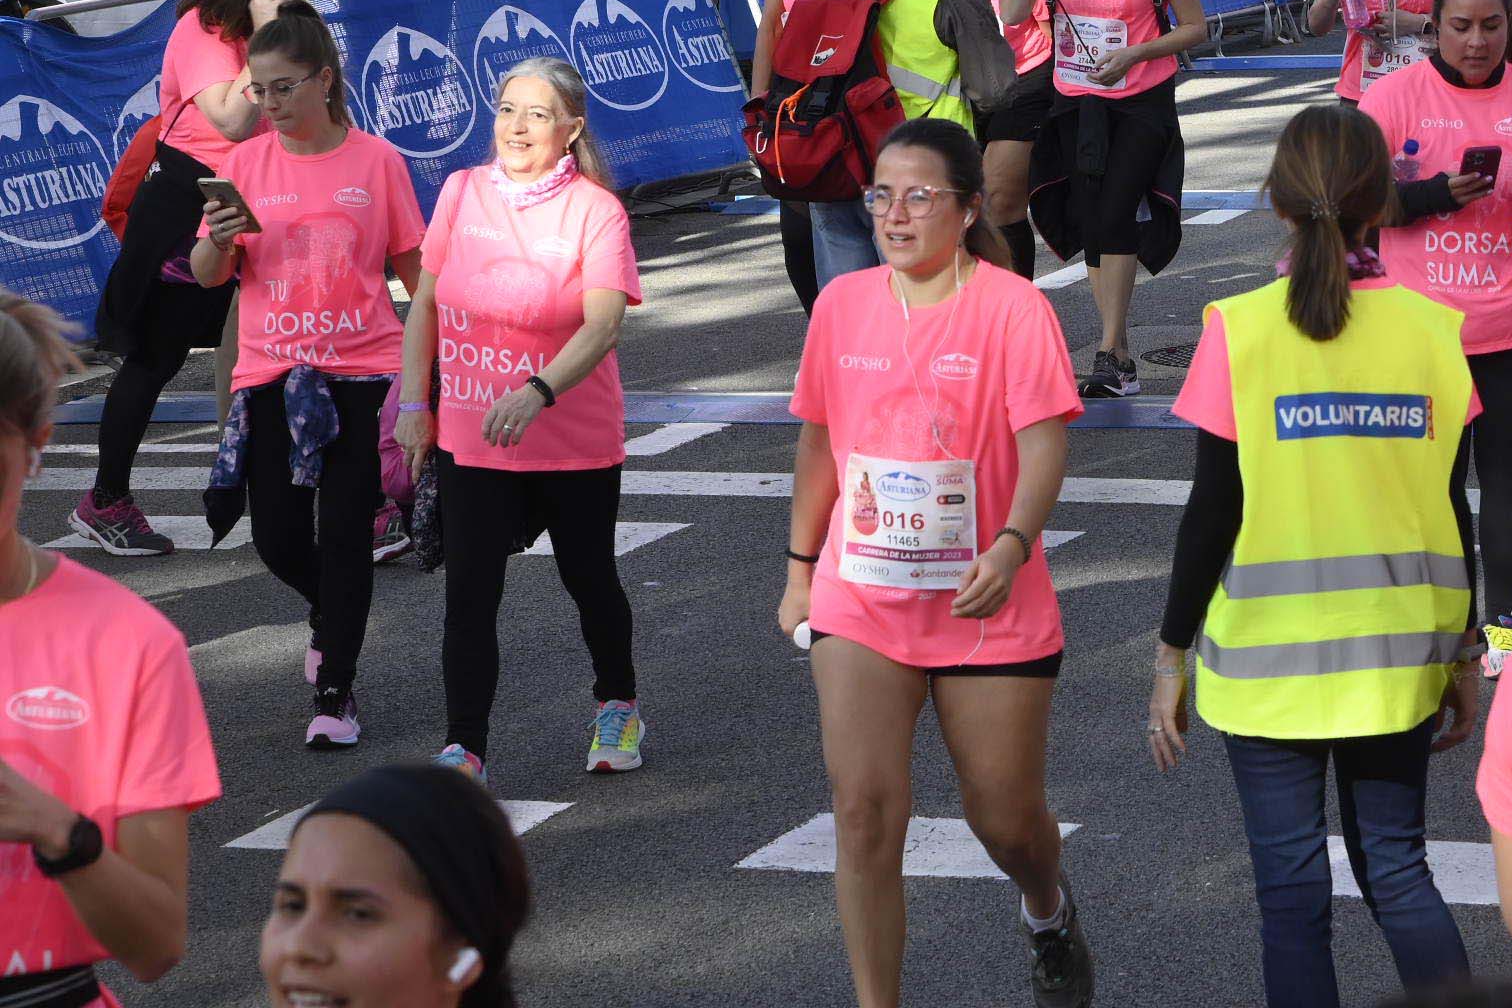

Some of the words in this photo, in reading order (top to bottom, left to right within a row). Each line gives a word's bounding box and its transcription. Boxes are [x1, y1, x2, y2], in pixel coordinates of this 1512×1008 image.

[588, 32, 614, 47] CENTRAL
[614, 28, 647, 43] LECHERA
[672, 24, 730, 69] ASTUR
[493, 50, 524, 65] CENTRAL
[524, 43, 560, 58] LECHERA
[579, 41, 664, 86] ASTURIANA
[1385, 52, 1411, 65] 016
[372, 80, 472, 138] ASTURIANA
[1420, 118, 1464, 130] OYSHO
[48, 140, 92, 158] LECHERA
[255, 192, 298, 208] OYSHO
[463, 224, 504, 242] OYSHO
[1426, 262, 1499, 286] SUMA
[264, 280, 288, 303] TU
[264, 310, 369, 336] DORSAL
[438, 304, 469, 332] TU
[263, 342, 343, 366] SUMA
[440, 338, 547, 378] DORSAL
[839, 354, 891, 372] OYSHO
[1278, 400, 1424, 427] VOLUNTARIS
[880, 480, 927, 495] ASTURIANA
[882, 510, 926, 530] 016
[886, 534, 920, 548] 11465
[858, 546, 888, 558] CARRERA
[888, 550, 900, 558] DE
[900, 550, 911, 560] LA
[912, 551, 940, 560] MUJER
[852, 562, 890, 577] OYSHO
